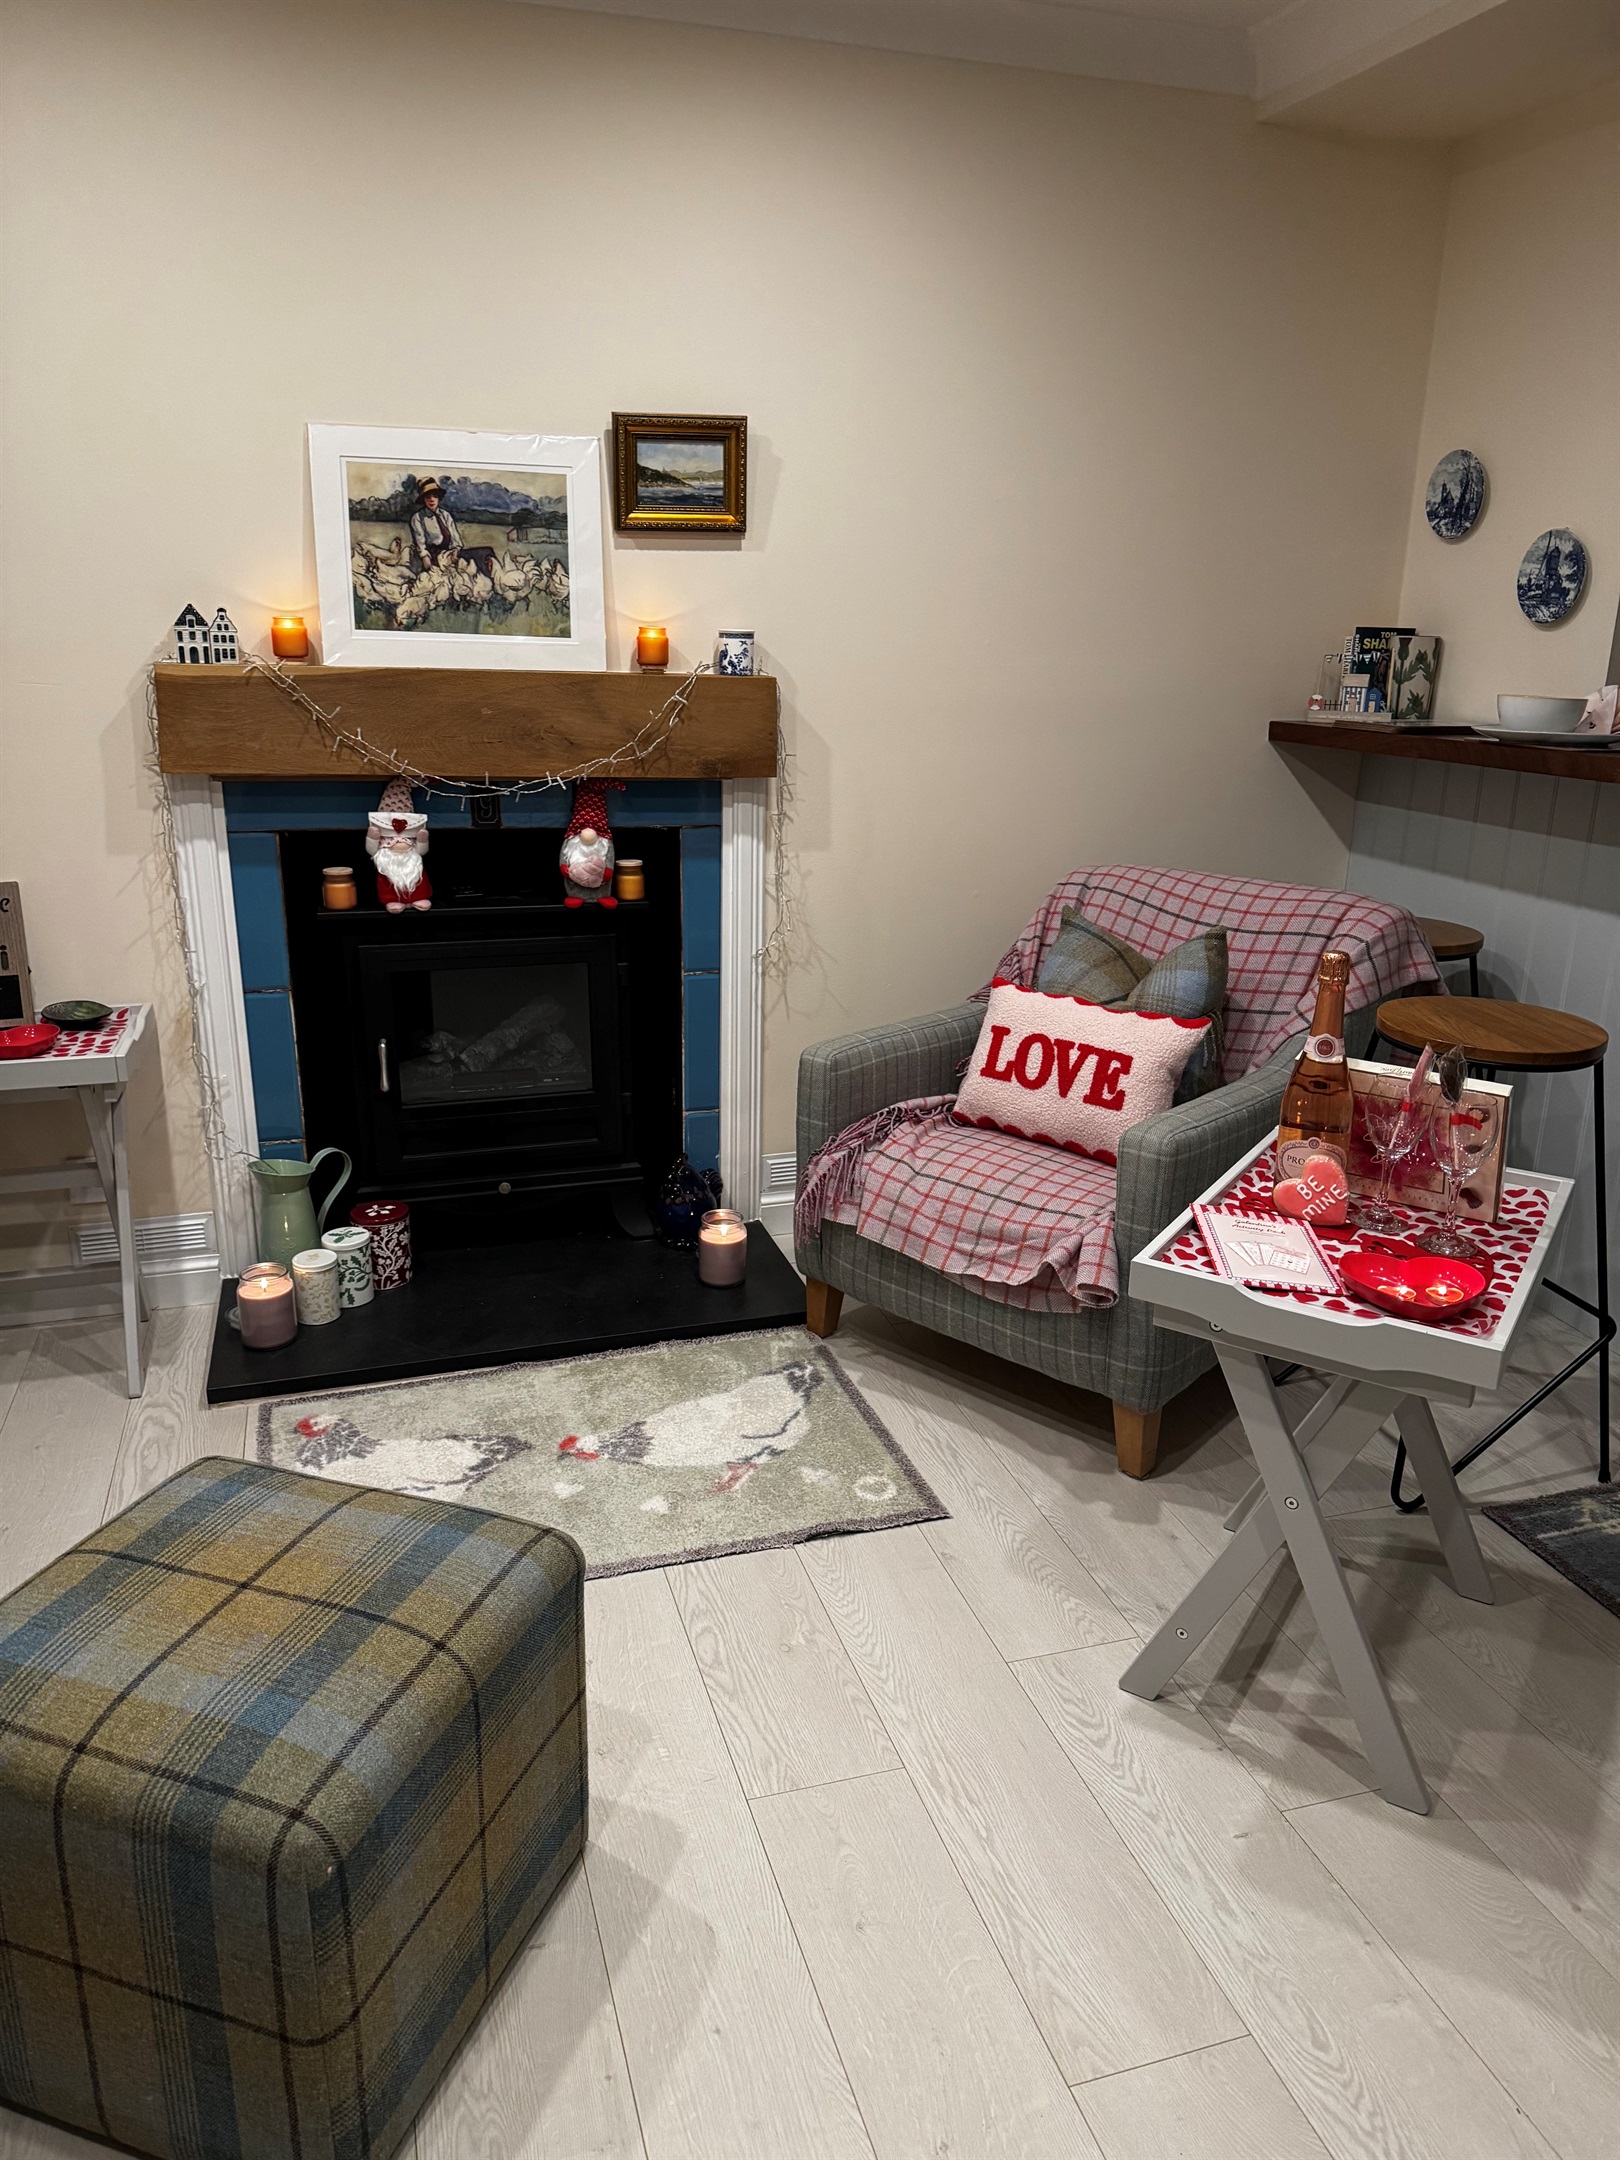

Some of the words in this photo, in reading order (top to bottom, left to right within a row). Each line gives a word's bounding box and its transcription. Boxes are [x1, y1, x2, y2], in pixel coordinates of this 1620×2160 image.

[1362, 638, 1390, 650] SHA
[979, 1024, 1134, 1112] LOVE
[1296, 1175, 1325, 1200] BE
[1302, 1184, 1348, 1221] MINE
[1231, 1224, 1264, 1233] Activity
